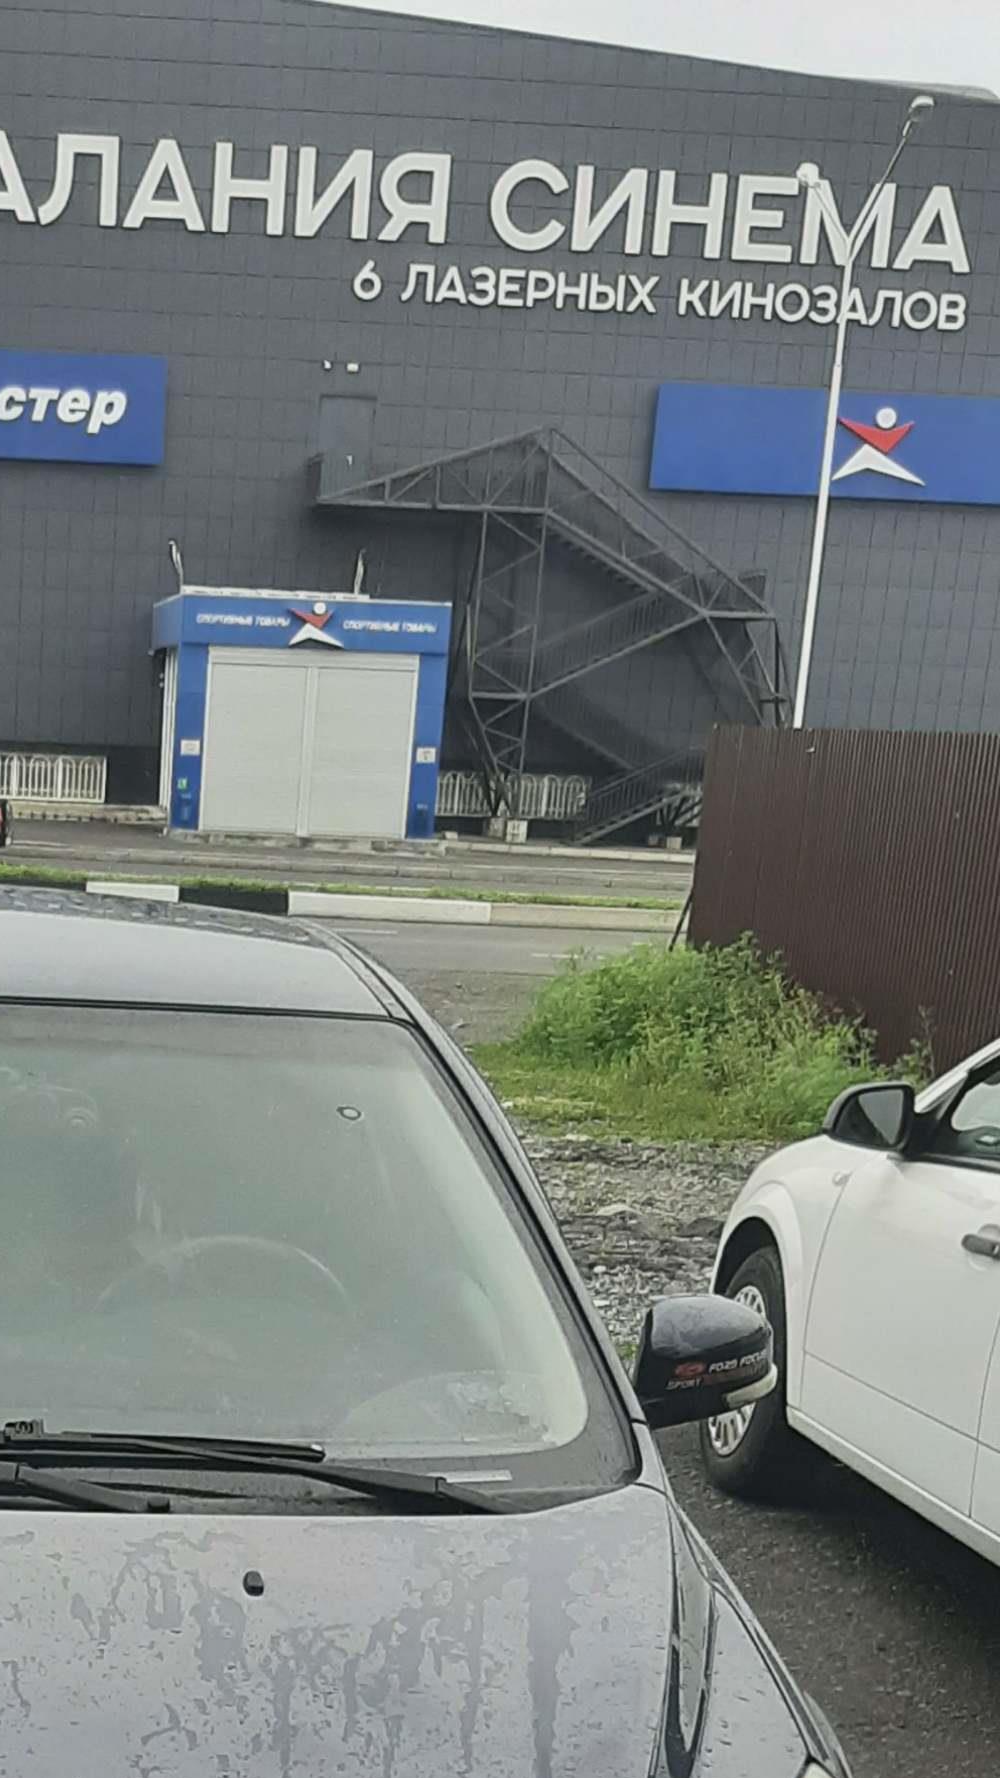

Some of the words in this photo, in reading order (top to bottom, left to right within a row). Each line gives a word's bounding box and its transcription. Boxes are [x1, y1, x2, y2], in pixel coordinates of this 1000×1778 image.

[489, 158, 970, 274] СИНЕМА
[352, 260, 381, 300] 6
[401, 263, 660, 314] ЛАЗЕРНЫХ
[677, 278, 967, 331] КИНОЗАЛОВ
